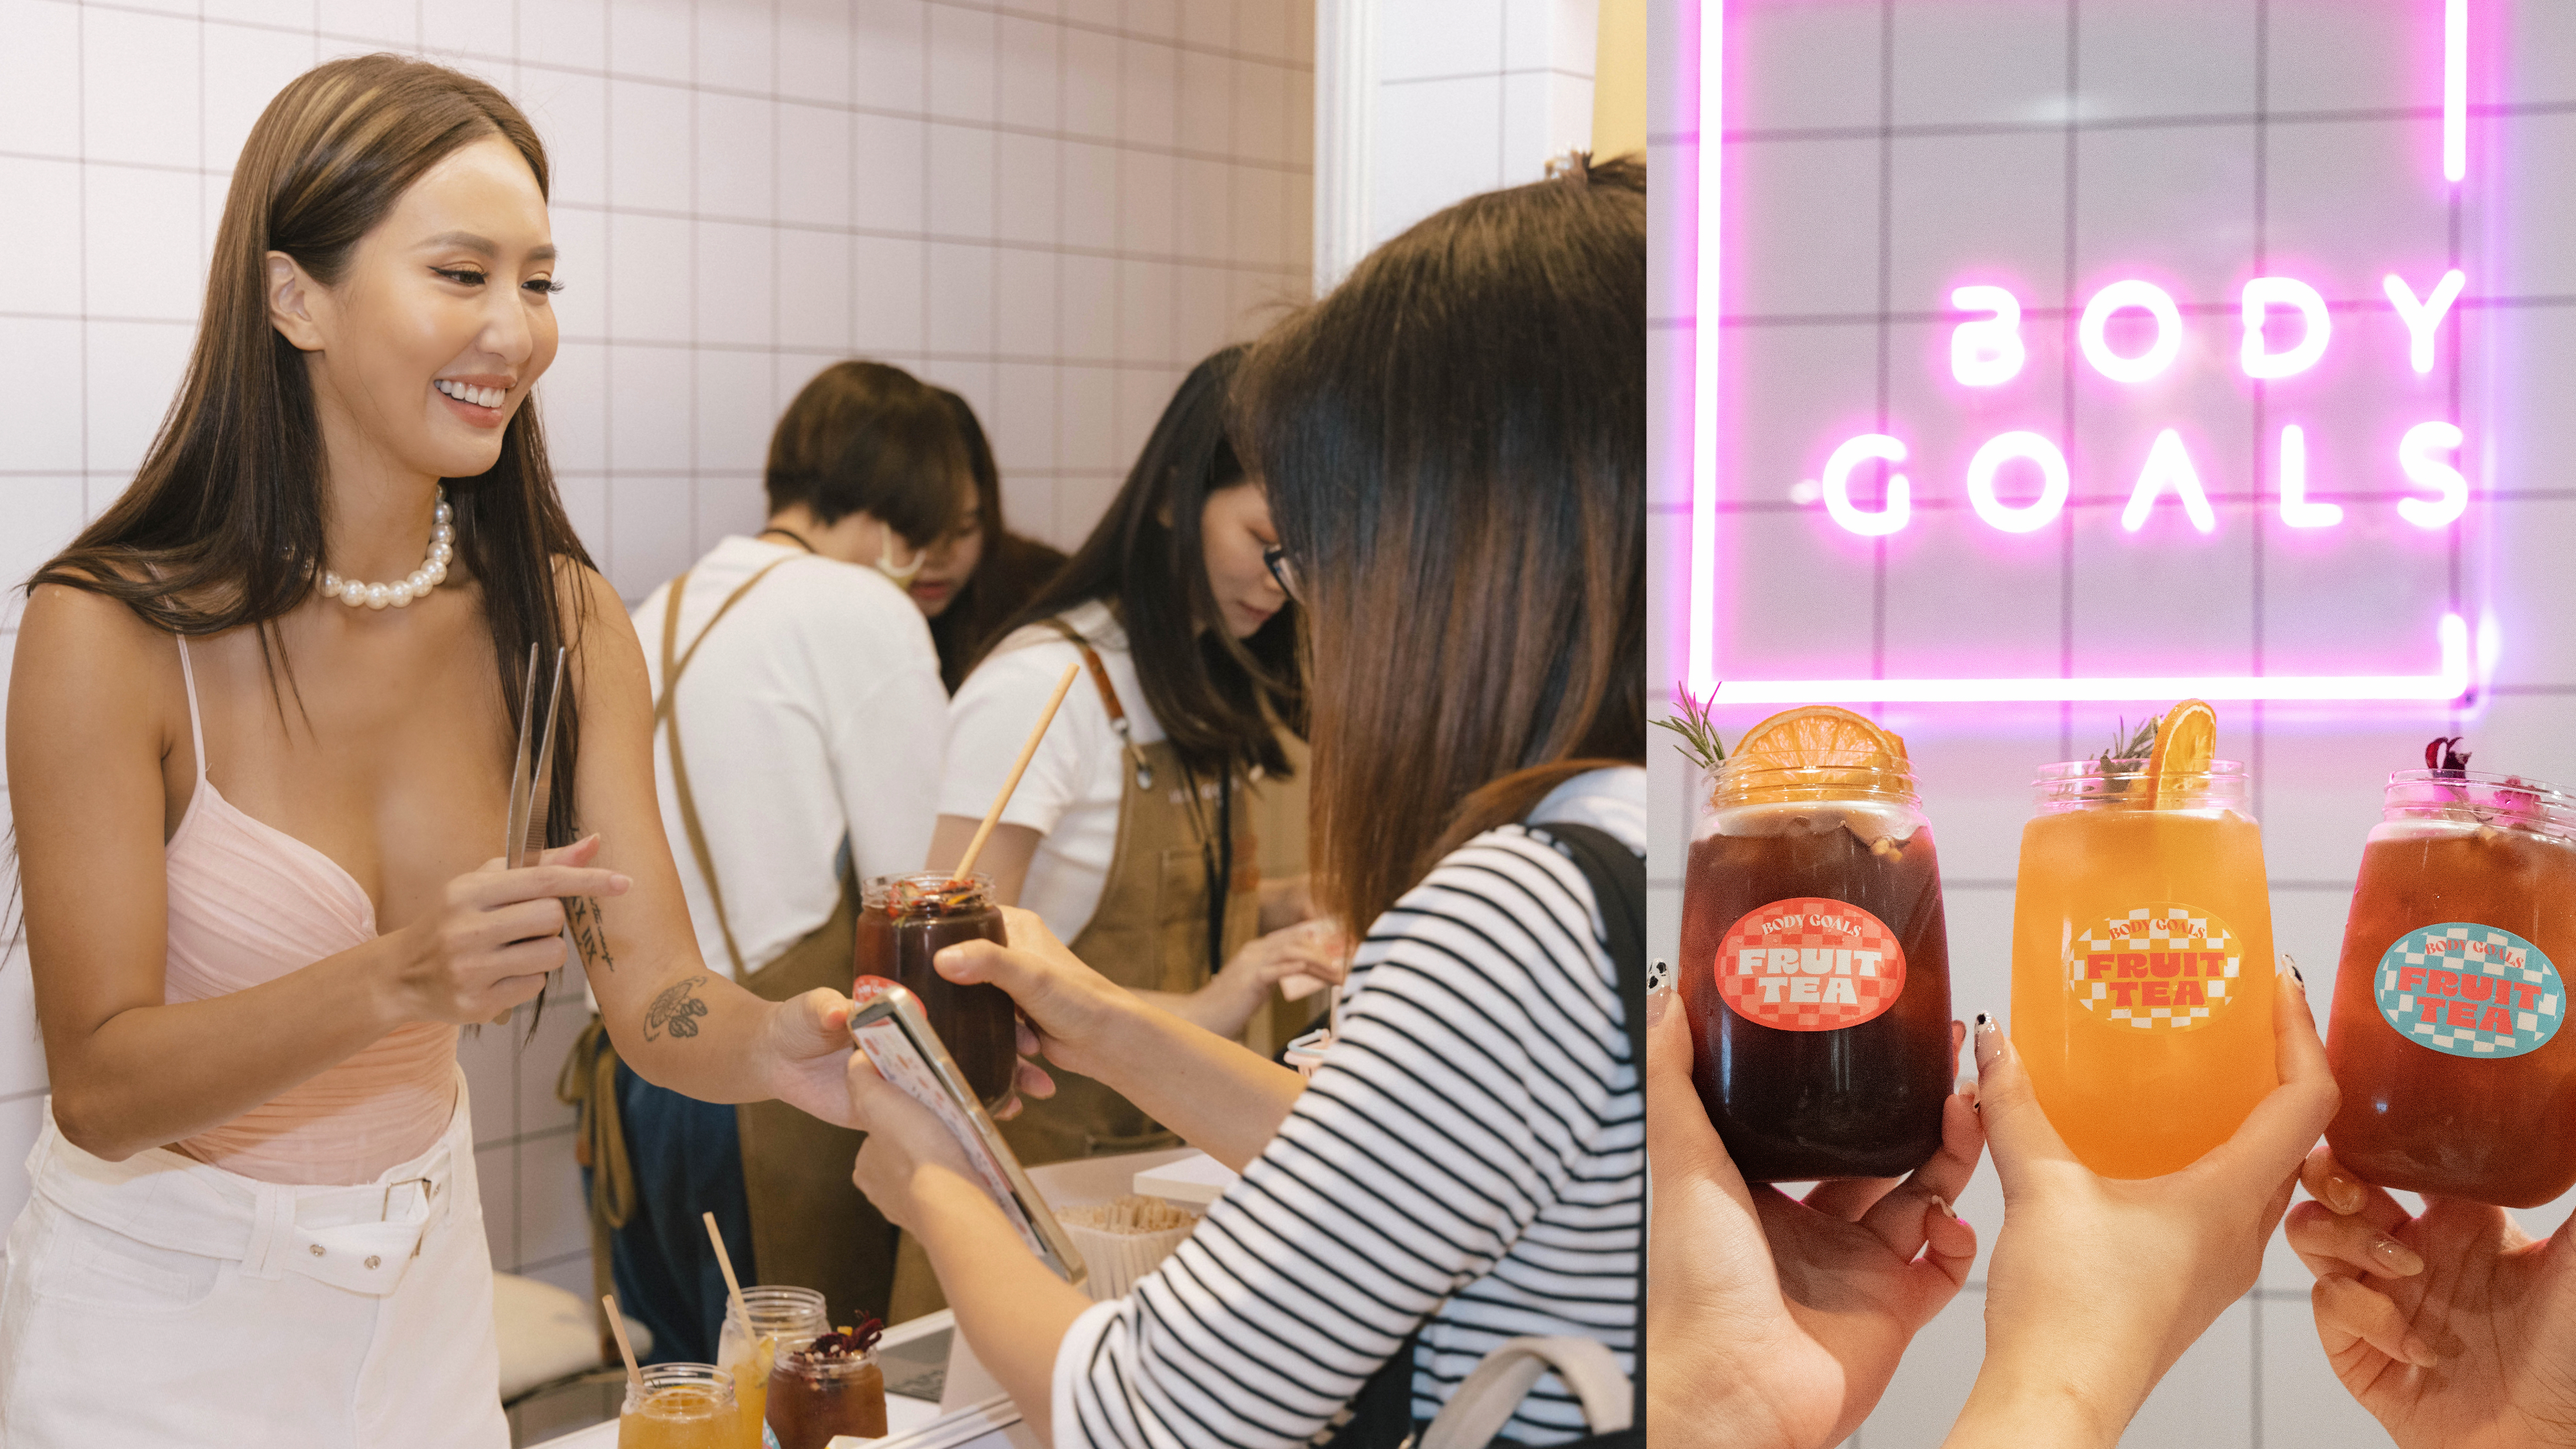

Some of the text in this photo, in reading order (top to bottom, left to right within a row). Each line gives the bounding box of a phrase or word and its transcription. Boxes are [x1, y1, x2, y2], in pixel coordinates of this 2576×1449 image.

[1950, 269, 2466, 386] BODY
[1822, 420, 2468, 536] GOALS
[1760, 914, 1863, 938] BODY GOALS
[2108, 918, 2206, 940] BODY GOALS
[1737, 947, 1882, 977] FRUIT
[2087, 951, 2226, 980] FRUIT
[2424, 939, 2525, 969] BODY GOALS
[1758, 976, 1858, 1004] TEA
[2109, 980, 2206, 1007] TEA
[2397, 965, 2542, 1011] FRUIT
[2416, 996, 2514, 1036] TEA
